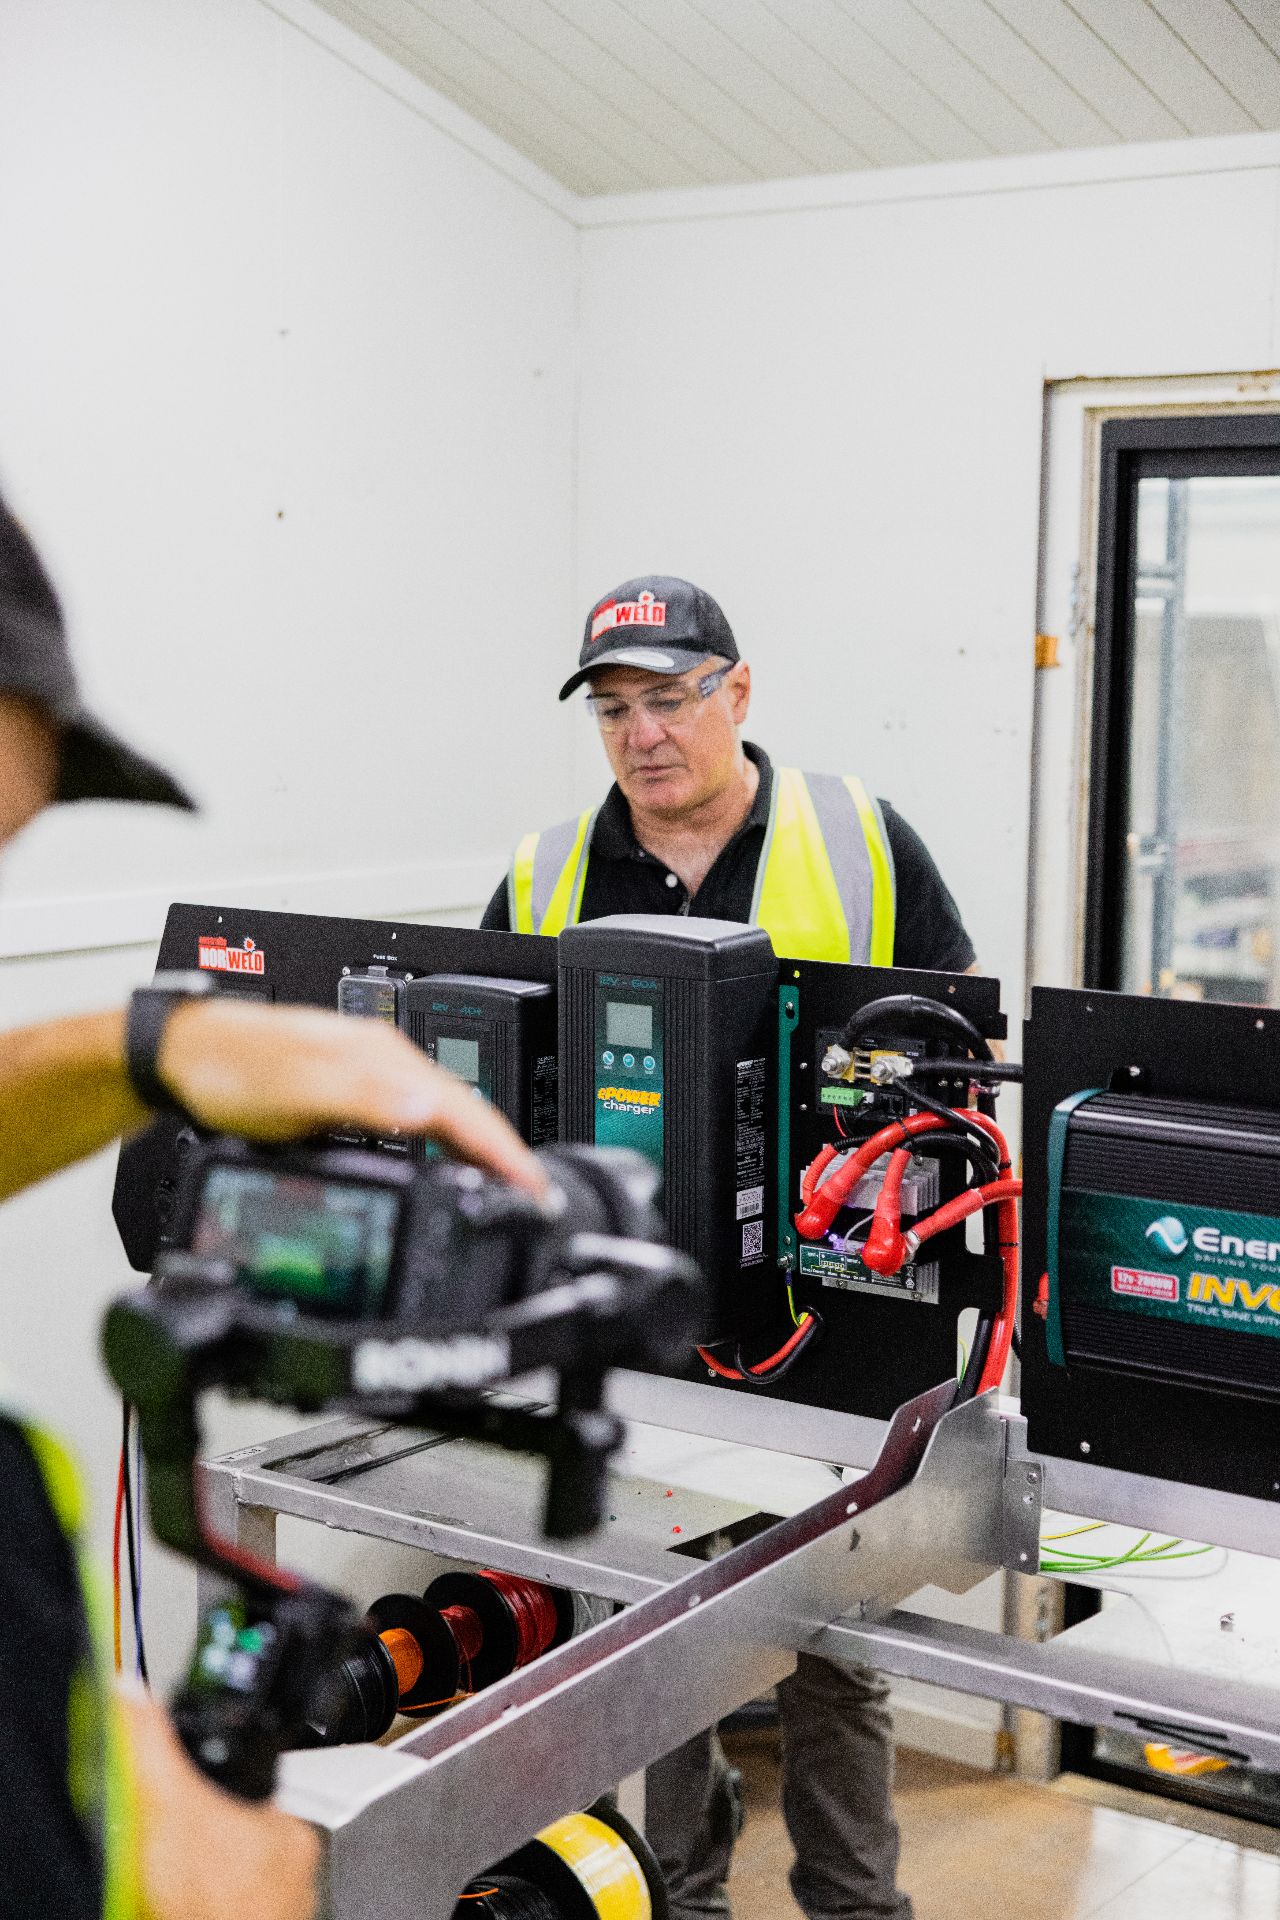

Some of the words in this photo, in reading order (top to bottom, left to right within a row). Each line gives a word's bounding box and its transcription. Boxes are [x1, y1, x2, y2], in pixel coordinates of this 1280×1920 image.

[603, 1100, 655, 1115] charger
[1187, 1302, 1220, 1316] TRUE
[1221, 1308, 1250, 1322] SINE
